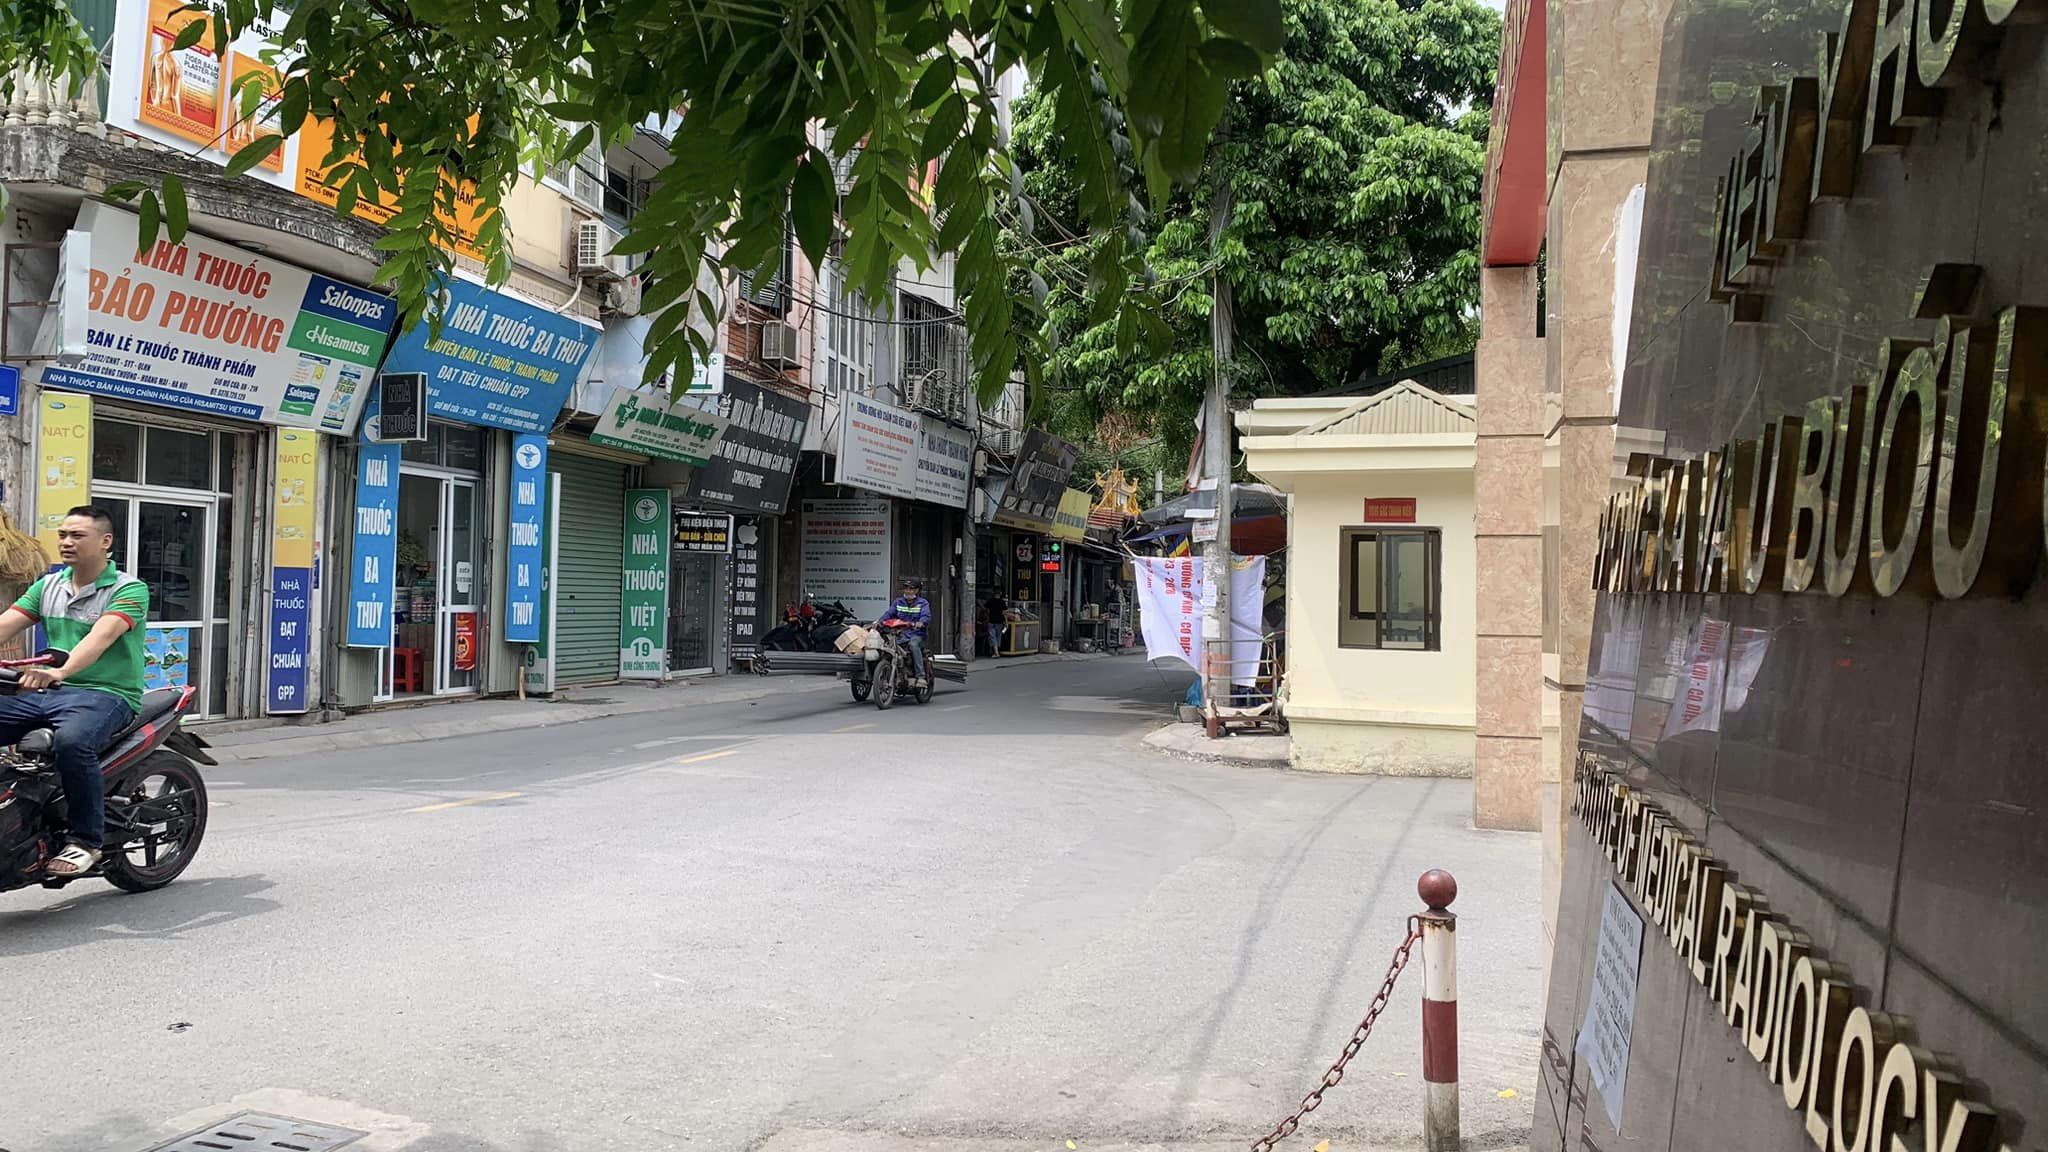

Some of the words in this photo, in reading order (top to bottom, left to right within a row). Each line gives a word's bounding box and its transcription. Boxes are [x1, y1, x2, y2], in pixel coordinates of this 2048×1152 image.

[134, 238, 189, 275] NHÀ
[193, 257, 272, 300] THUỐC
[88, 266, 155, 323] BẢO
[158, 290, 285, 354] PHƯƠNG
[320, 285, 385, 320] Salonpas
[305, 324, 370, 357] Hisamitsu
[449, 303, 488, 336] NHÀ
[484, 314, 535, 350] THUỐC
[530, 330, 555, 357] BA
[135, 340, 179, 362] THUỐC
[181, 350, 222, 371] THÀNH
[222, 358, 257, 378] PHẨM
[48, 372, 66, 385] NHÀ
[68, 375, 96, 389] THUỐC
[95, 380, 115, 391] BÁN
[113, 385, 136, 395] HÀNG
[135, 388, 159, 400] CHÍNH
[241, 408, 257, 416] NAM
[437, 365, 459, 384] ĐẠT
[459, 369, 480, 387] TIÊU
[480, 374, 511, 397] CHUẨN
[510, 385, 530, 400] GPP
[72, 424, 86, 439] C
[365, 454, 389, 487] NHÀ
[517, 477, 536, 506] NHÀ
[357, 499, 392, 537] THUỐC
[512, 515, 538, 547] THUỐC
[632, 530, 658, 555] NHÀ
[280, 579, 300, 591] NHÀ
[364, 556, 379, 584] BA
[517, 564, 530, 588] BA
[624, 562, 665, 591] THUỐC
[274, 597, 305, 609] THUỐC
[356, 592, 384, 629] THỦY
[512, 594, 534, 626] THỦY
[630, 602, 657, 632] VIỆT
[279, 621, 298, 641] ĐẠT
[736, 623, 753, 636] IPAD
[273, 648, 302, 669] CHUẨN
[633, 642, 650, 657] 19
[278, 685, 295, 700] GPP
[1616, 790, 1641, 881] OF
[1634, 806, 1711, 986] MEDICAL
